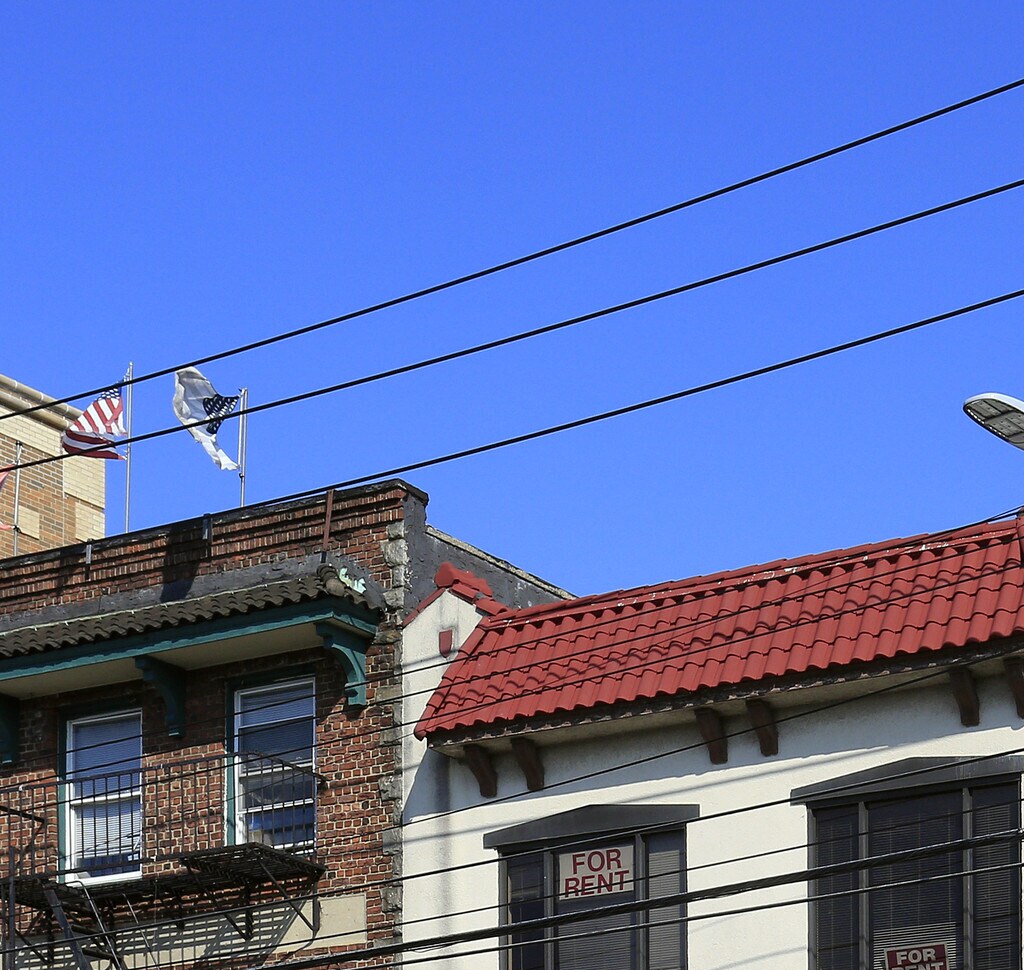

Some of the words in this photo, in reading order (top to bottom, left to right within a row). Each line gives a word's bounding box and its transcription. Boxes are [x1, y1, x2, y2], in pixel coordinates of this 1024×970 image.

[572, 848, 622, 875] FOR
[564, 869, 629, 898] RENT
[896, 948, 936, 965] FOR
